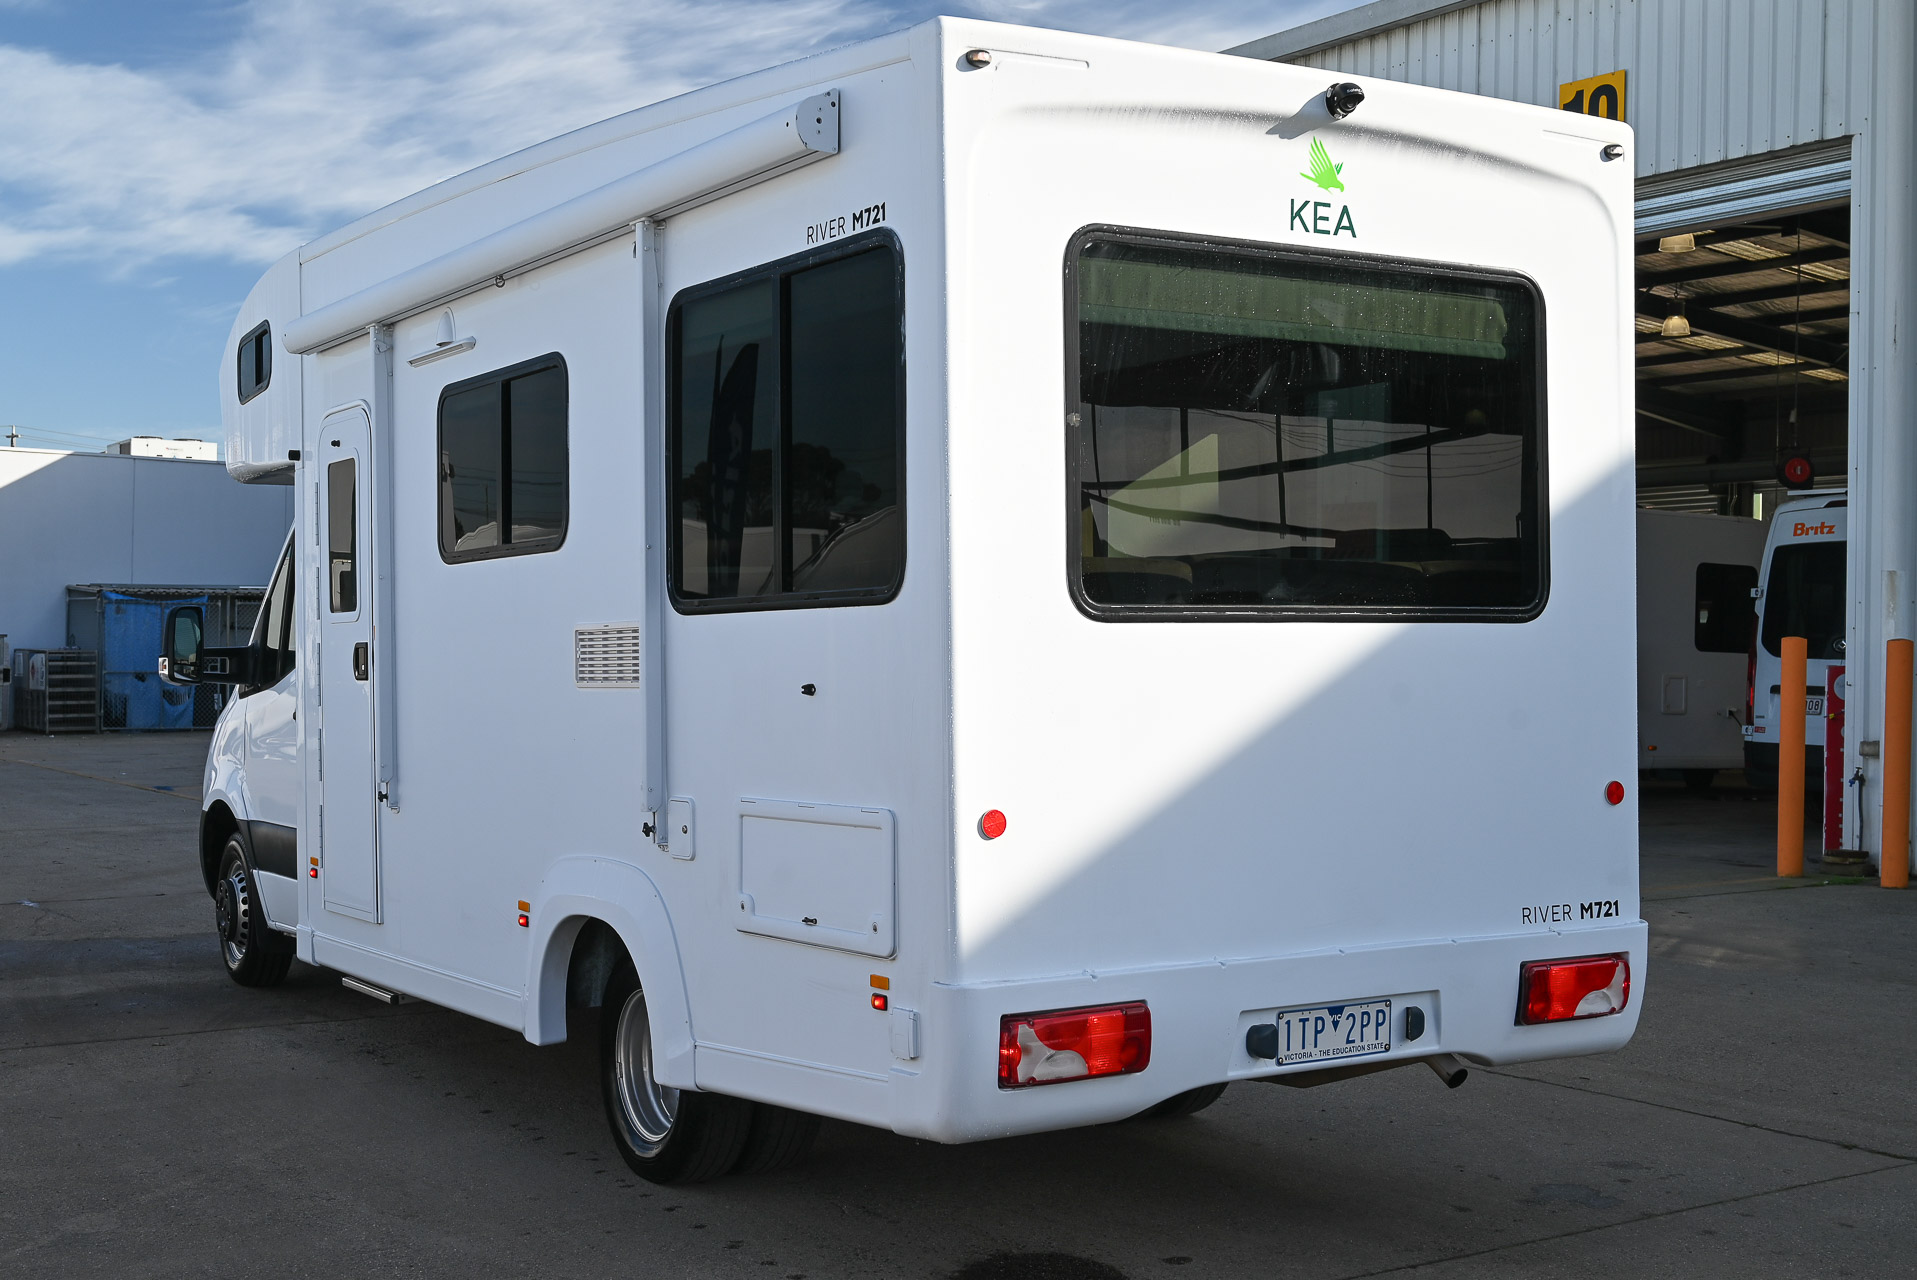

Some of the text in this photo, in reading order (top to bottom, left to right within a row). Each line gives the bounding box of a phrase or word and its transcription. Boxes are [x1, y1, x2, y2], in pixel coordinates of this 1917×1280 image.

[807, 201, 886, 245] RIVER M721
[1290, 198, 1357, 238] KEA
[1793, 521, 1836, 537] Britz
[1522, 899, 1620, 925] RIVER M721
[1284, 1008, 1387, 1052] 1TP 2PP
[1284, 1051, 1313, 1061] VICTORIA
[1319, 1048, 1331, 1057] THE
[1332, 1044, 1366, 1055] EDUCATION
[1367, 1042, 1384, 1051] STATE
